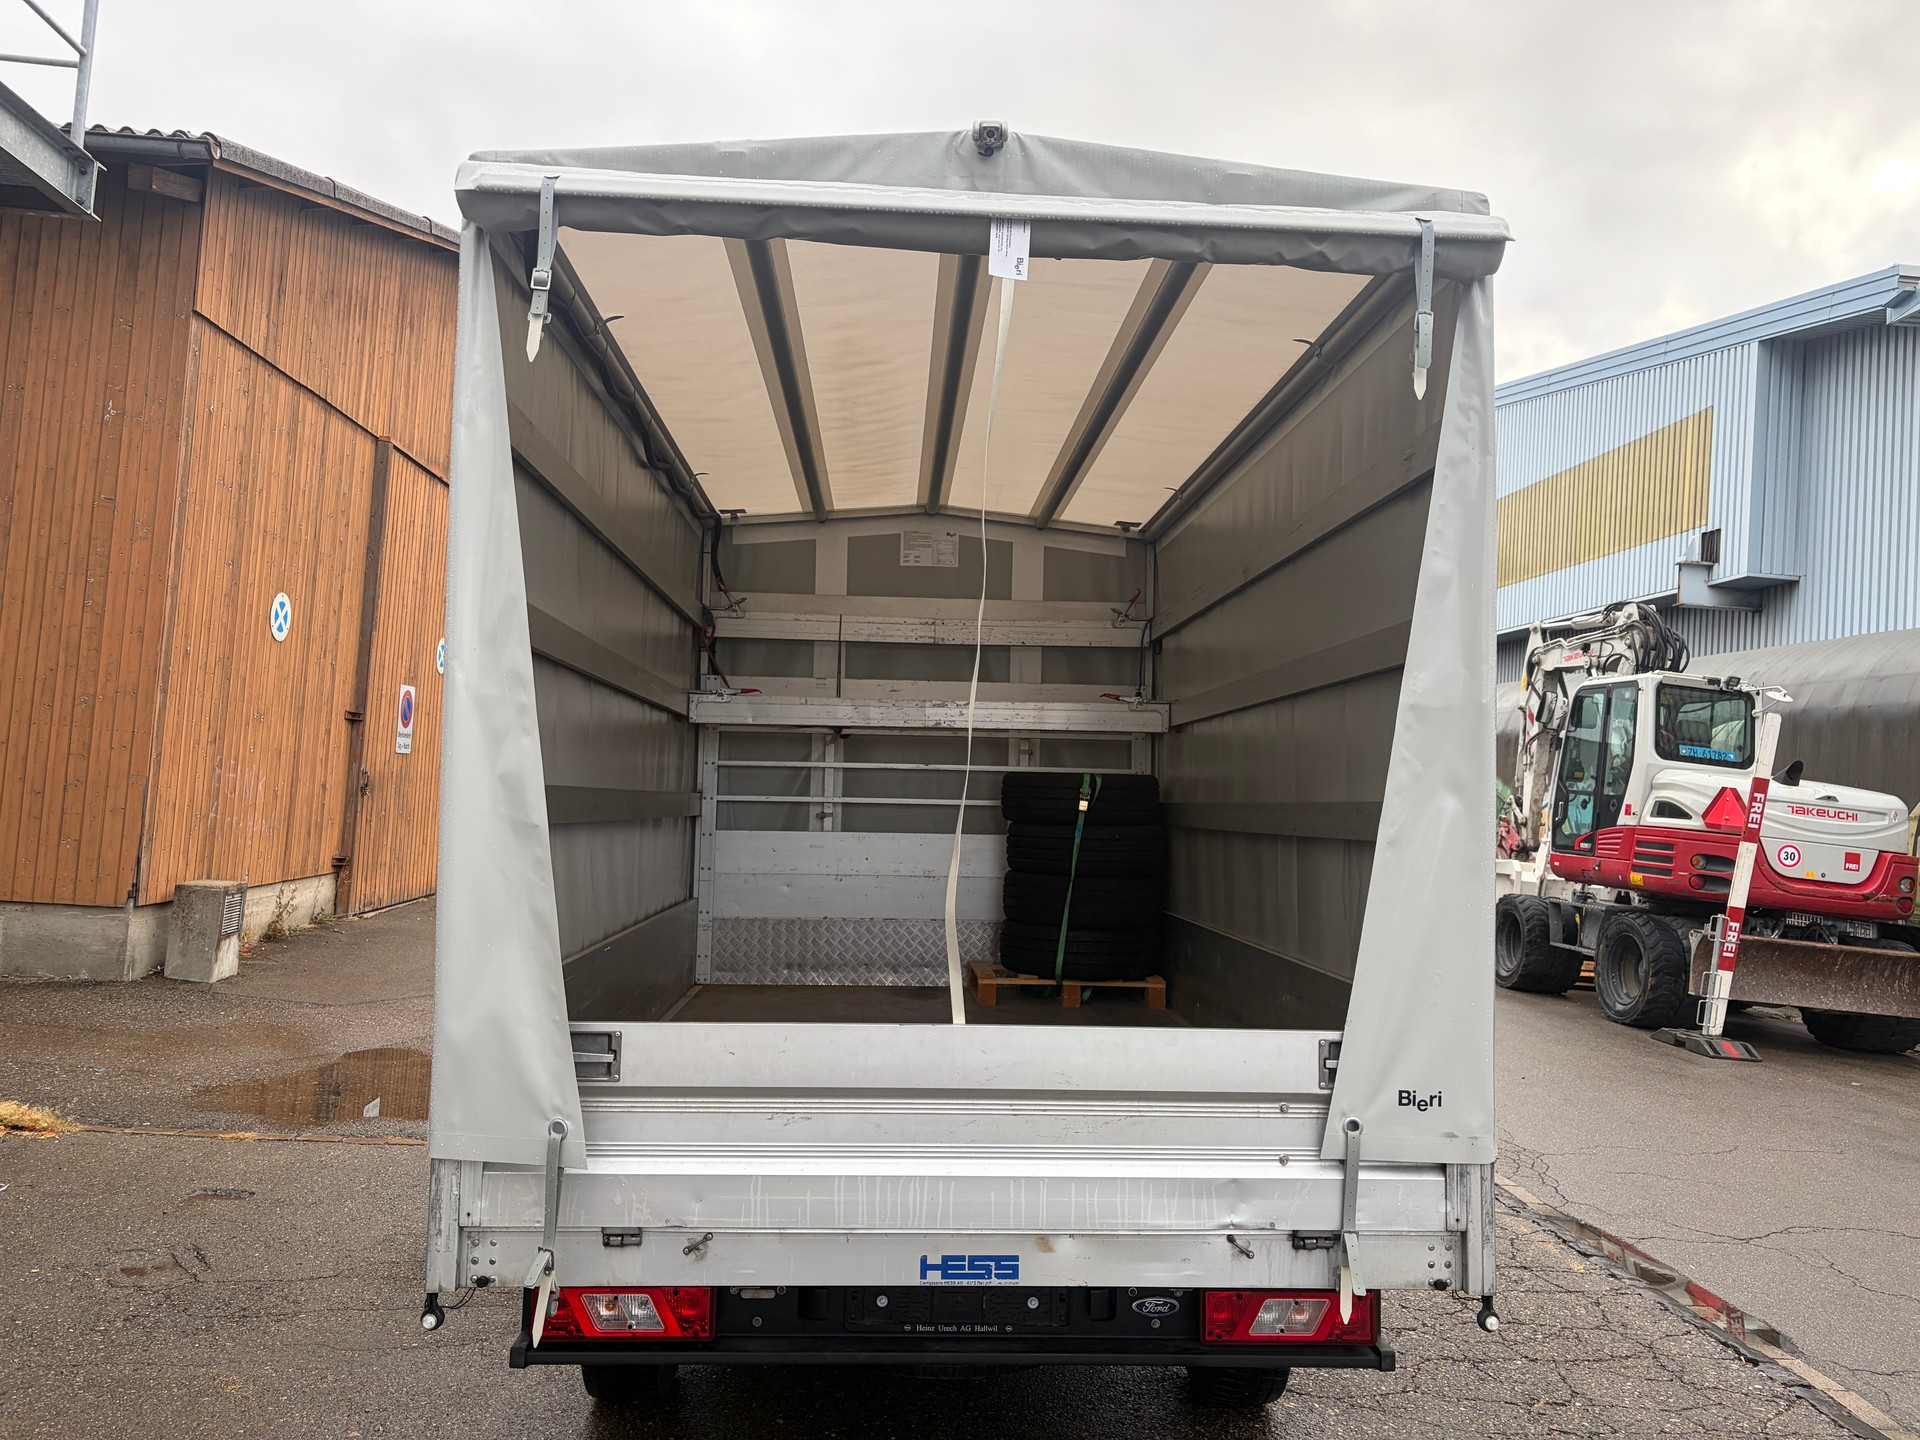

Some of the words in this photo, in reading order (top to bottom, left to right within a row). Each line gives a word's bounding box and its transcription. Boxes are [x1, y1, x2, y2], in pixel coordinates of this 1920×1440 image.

[1014, 257, 1024, 276] Bieri
[1747, 792, 1765, 829] FREI
[1783, 851, 1796, 861] 30
[1722, 921, 1740, 958] FREI
[1398, 1089, 1443, 1112] Bieri
[920, 1255, 1019, 1280] HESS
[1142, 1301, 1171, 1313] Ford
[916, 1324, 935, 1332] Heinz
